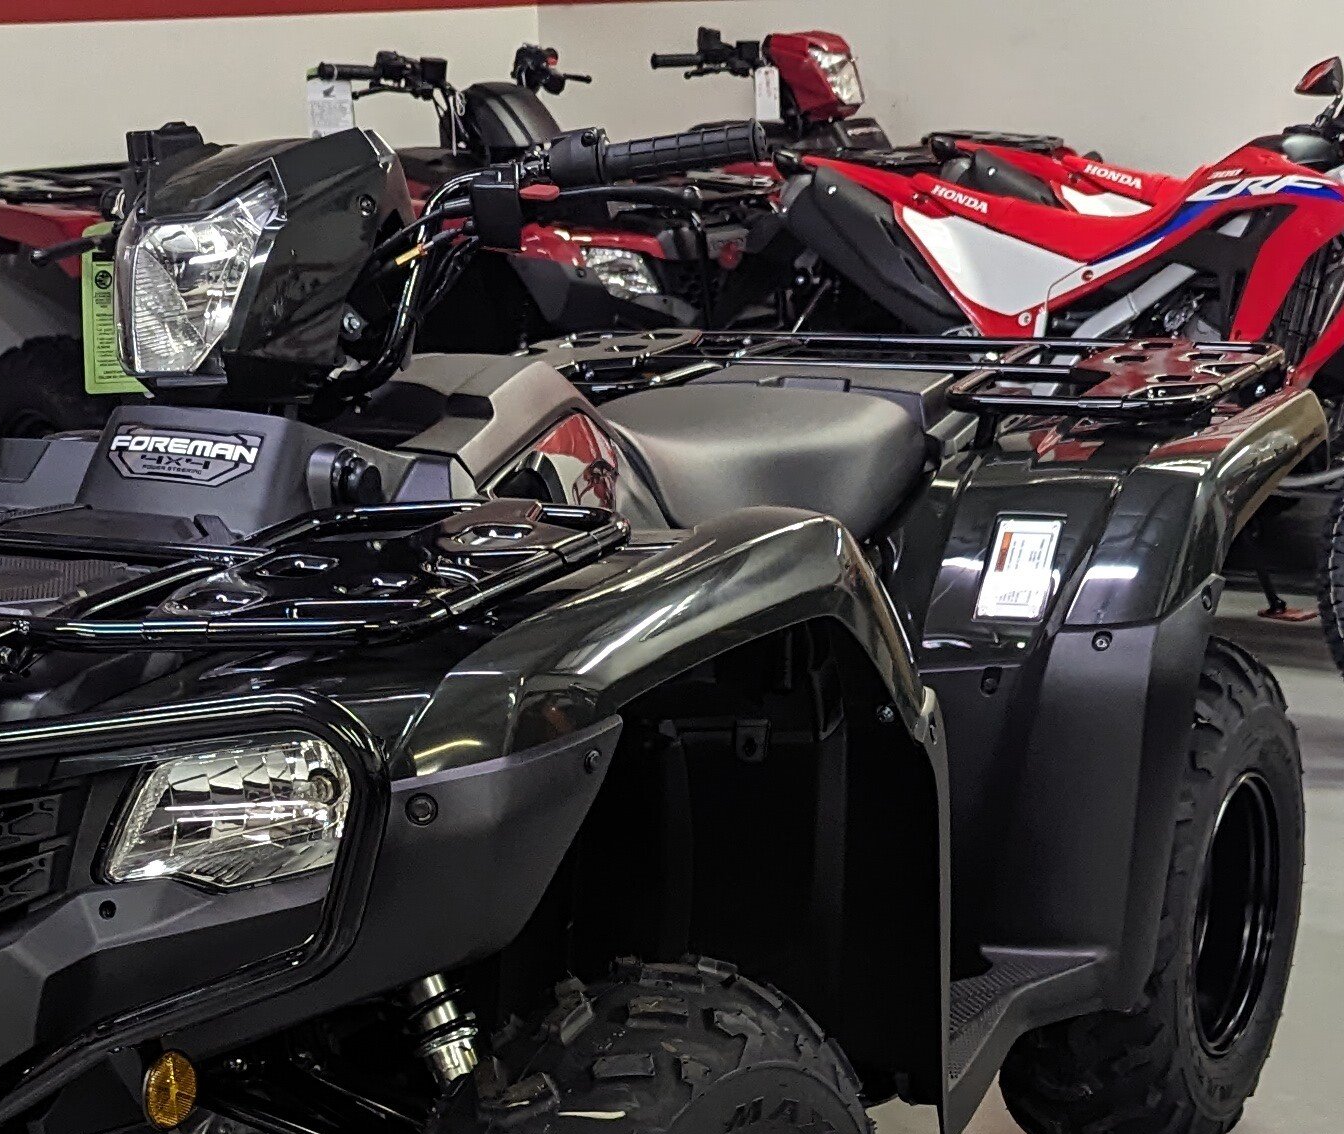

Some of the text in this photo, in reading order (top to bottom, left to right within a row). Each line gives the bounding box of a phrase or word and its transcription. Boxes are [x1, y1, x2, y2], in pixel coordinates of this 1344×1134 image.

[1083, 163, 1143, 190] HONDA
[1185, 173, 1340, 202] CRF
[930, 183, 989, 214] HONDA
[110, 435, 259, 464] FOREMAN
[142, 463, 203, 475] POWER STEERING
